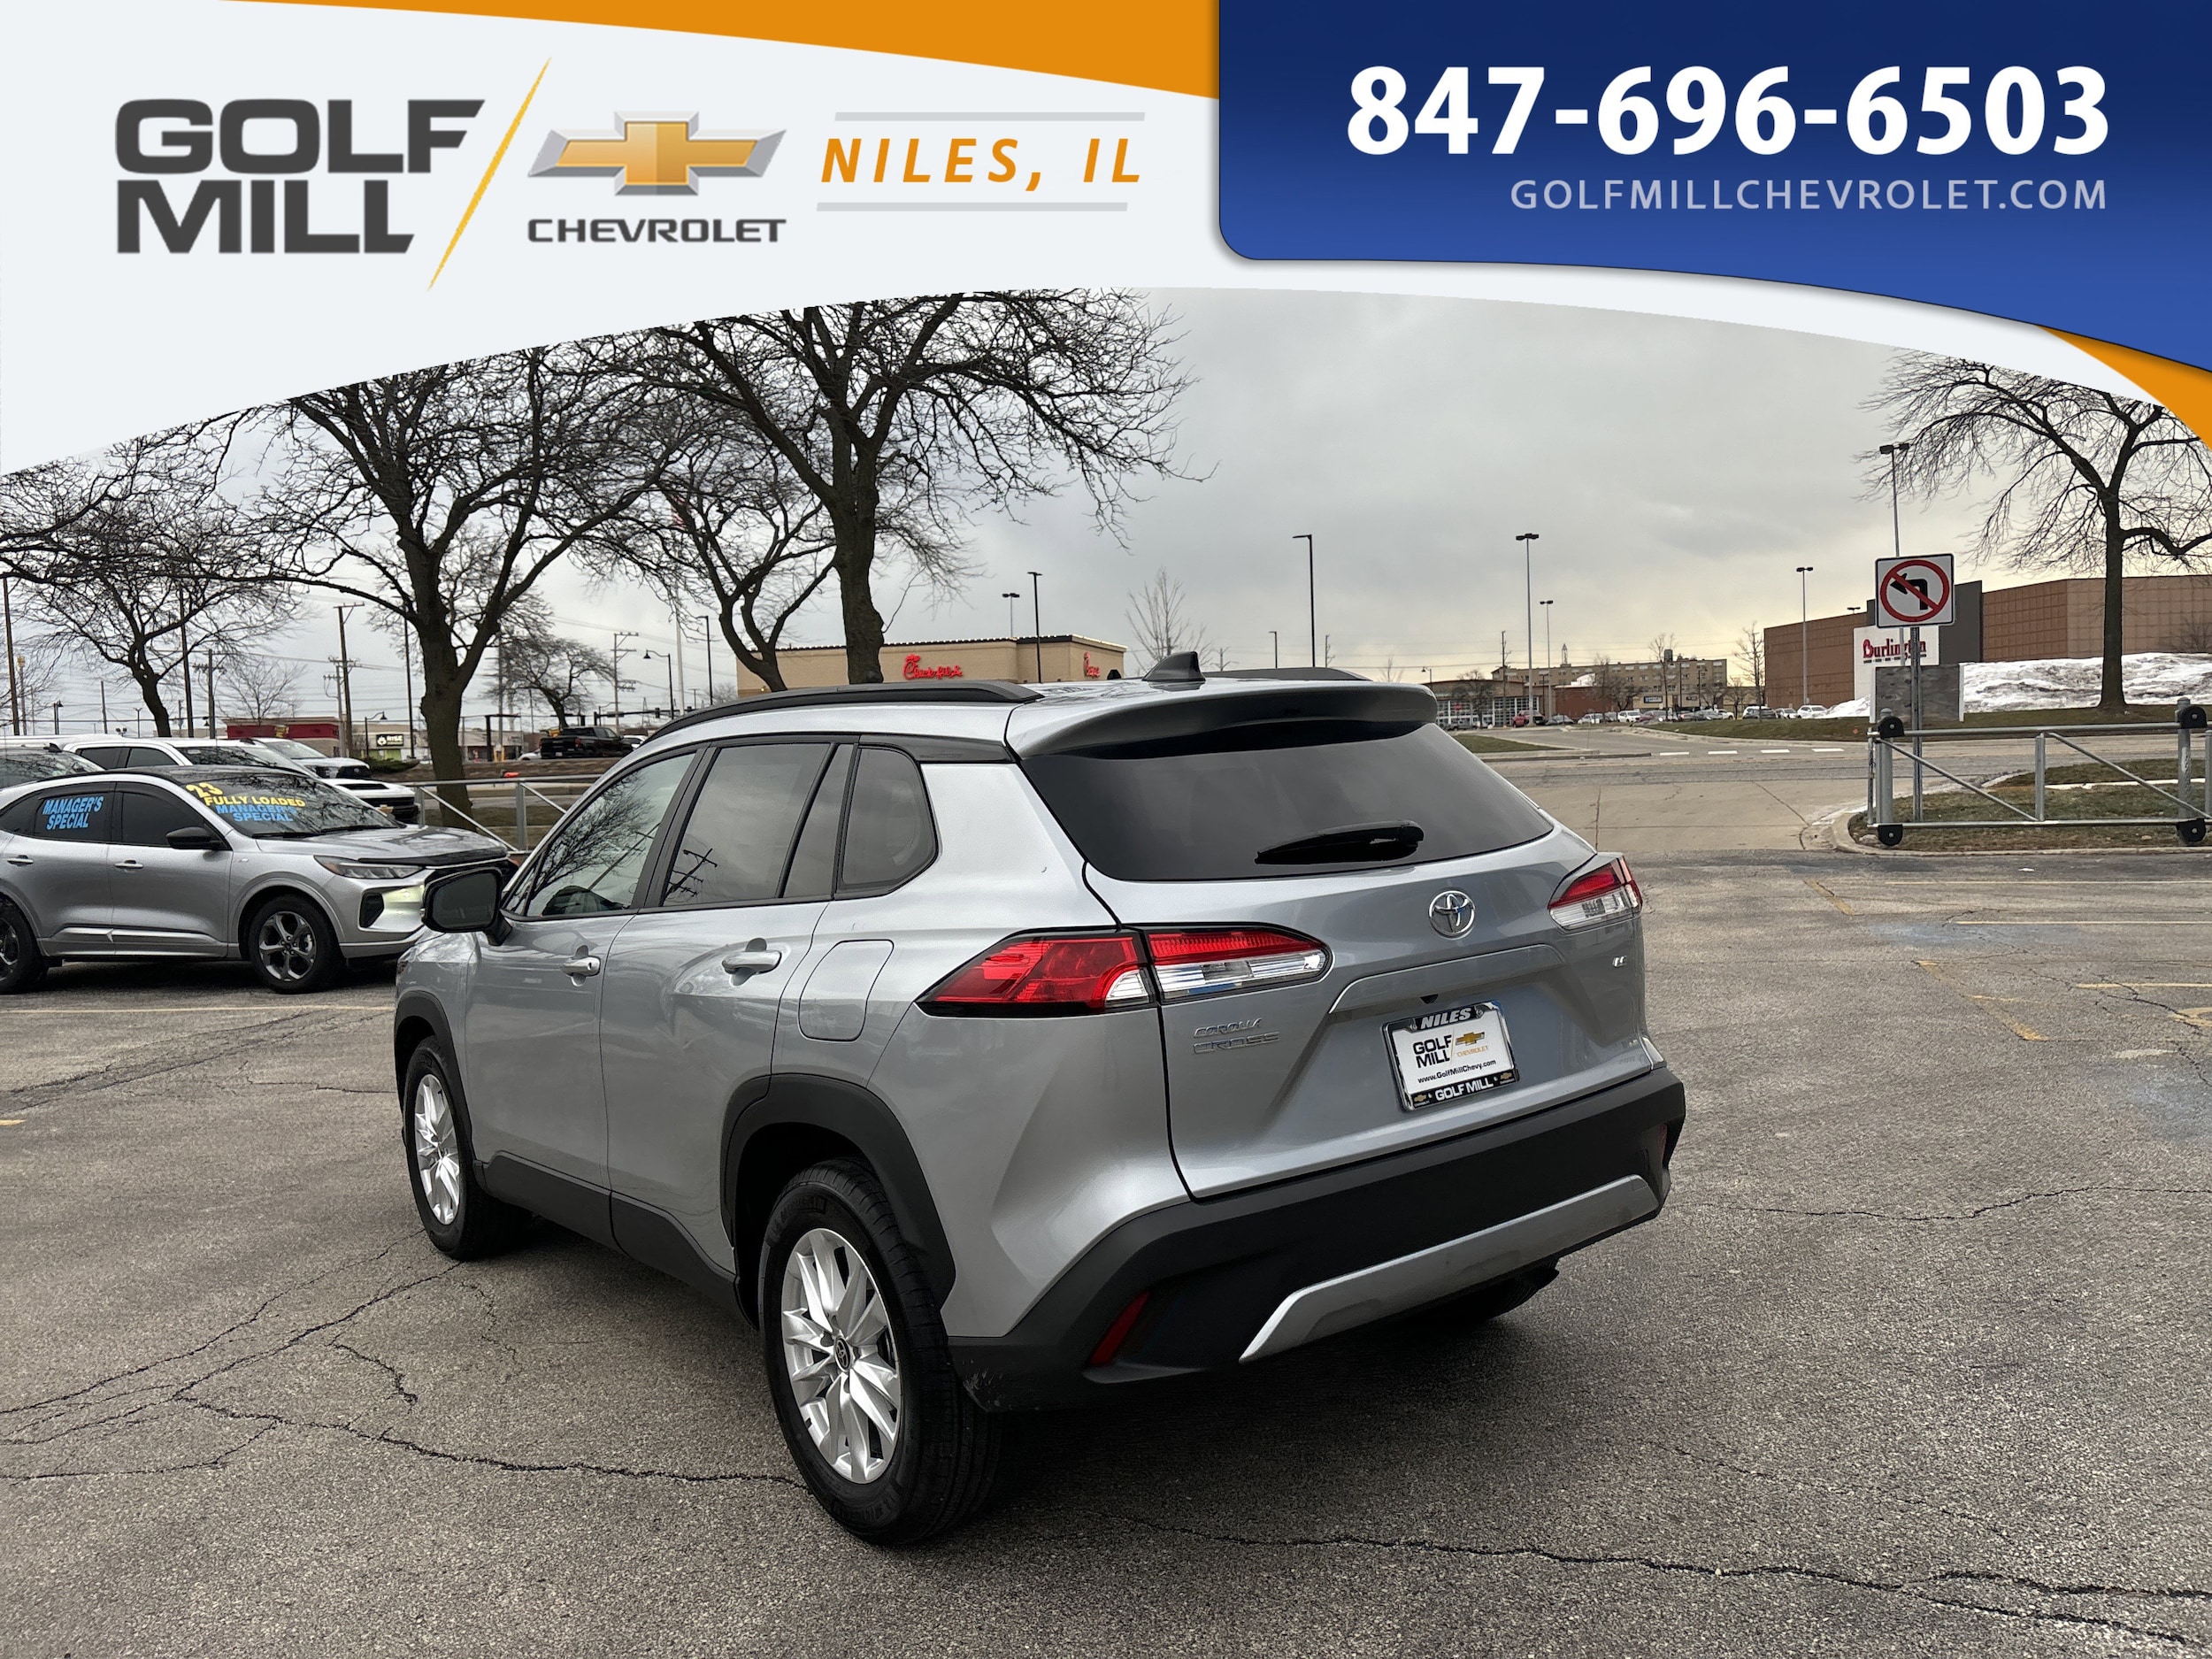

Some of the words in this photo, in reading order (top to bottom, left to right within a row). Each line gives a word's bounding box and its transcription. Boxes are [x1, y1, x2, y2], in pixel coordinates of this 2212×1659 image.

[186, 782, 223, 797] 23
[42, 796, 104, 814] MANAGER'S
[204, 795, 248, 806] FULLY
[251, 796, 306, 807] LOADED
[215, 804, 297, 815] MANAGER'S
[46, 813, 88, 830] SPECIAL
[233, 812, 293, 822] SPECIAL
[1194, 1018, 1263, 1038] COROLLA
[1420, 1007, 1472, 1030] NILES
[1412, 1034, 1452, 1055] GOLF
[1416, 1049, 1450, 1069] MILL
[1417, 1059, 1496, 1084] www.GolfMillChevy.com
[1435, 1085, 1465, 1101] GOLF
[1466, 1077, 1494, 1093] MILL
